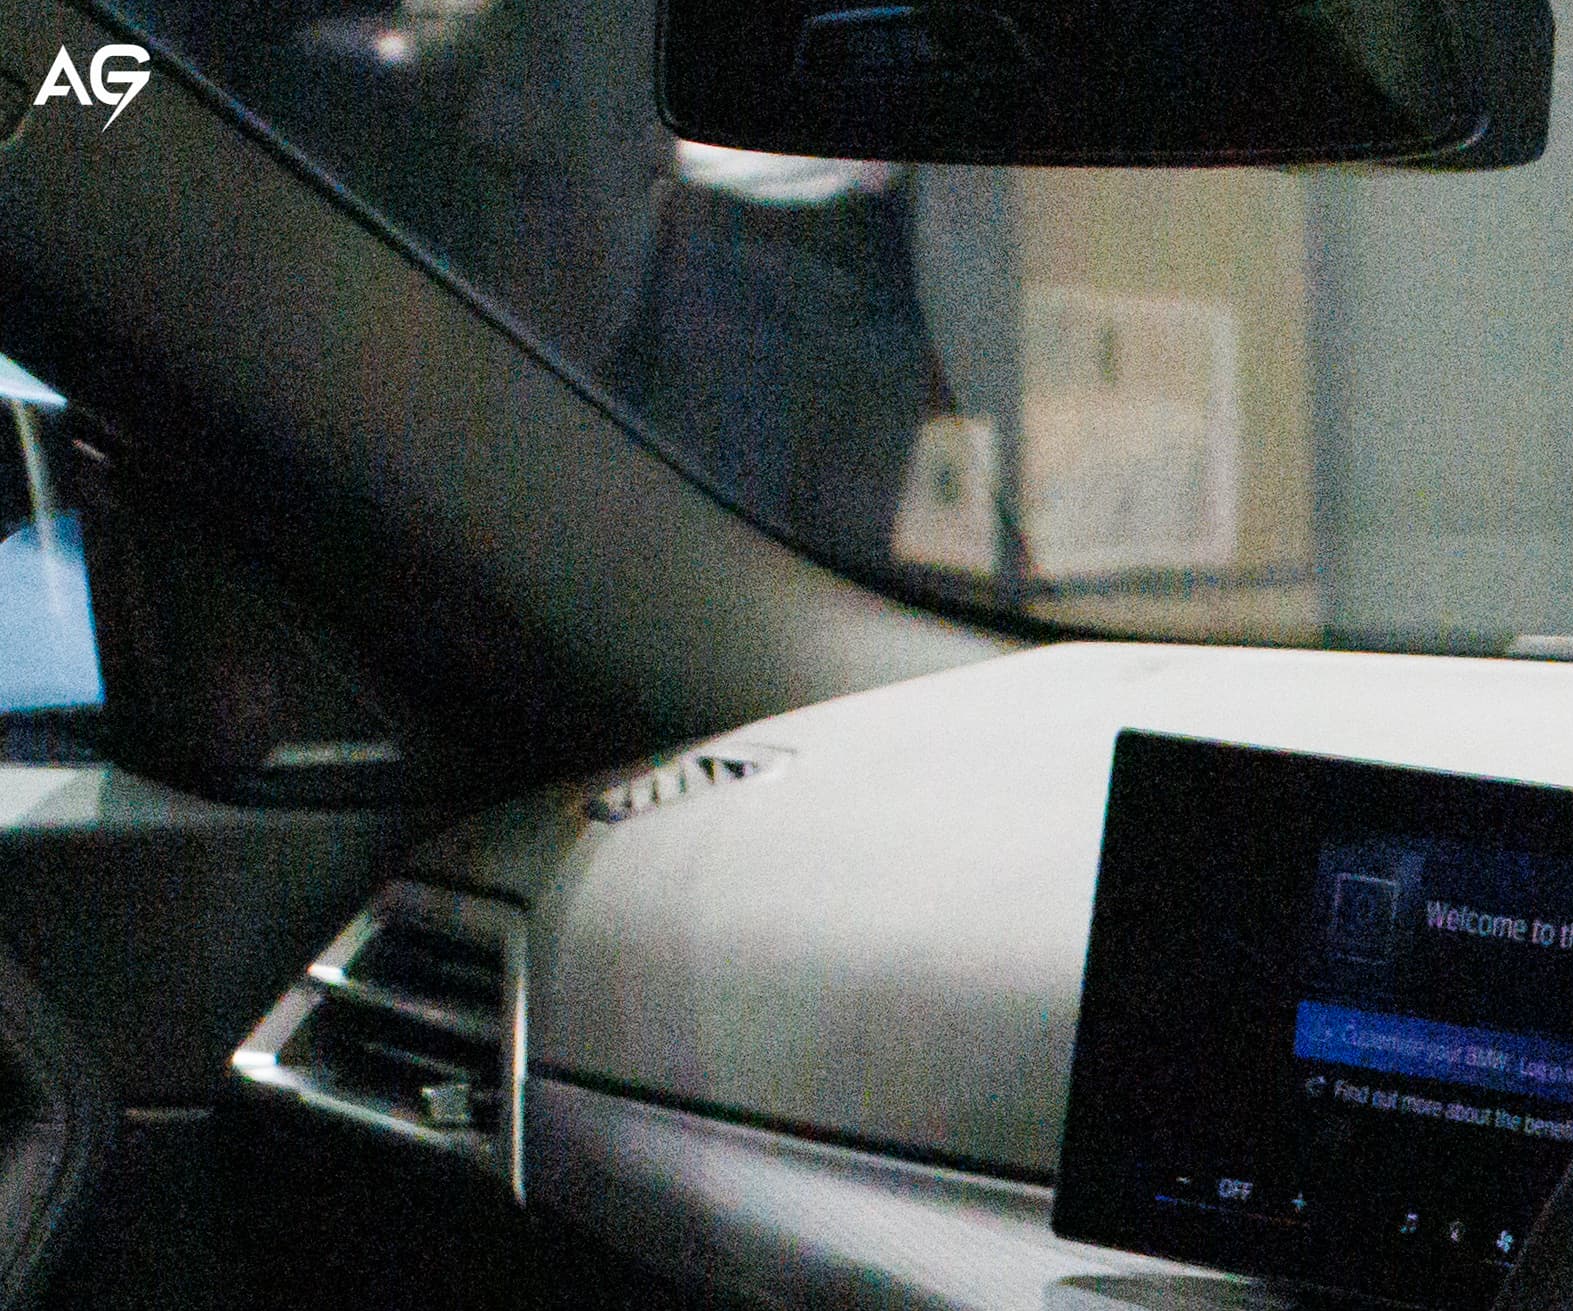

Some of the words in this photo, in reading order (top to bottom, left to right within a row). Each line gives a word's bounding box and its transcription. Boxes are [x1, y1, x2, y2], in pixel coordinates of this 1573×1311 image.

[1427, 900, 1527, 941] Welcome
[1531, 918, 1554, 947] to
[1334, 1079, 1369, 1103] Find
[1371, 1090, 1398, 1110] out
[1401, 1095, 1443, 1118] more
[1445, 1101, 1492, 1126] about
[1494, 1107, 1521, 1131] the
[1218, 1178, 1253, 1200] OFF
